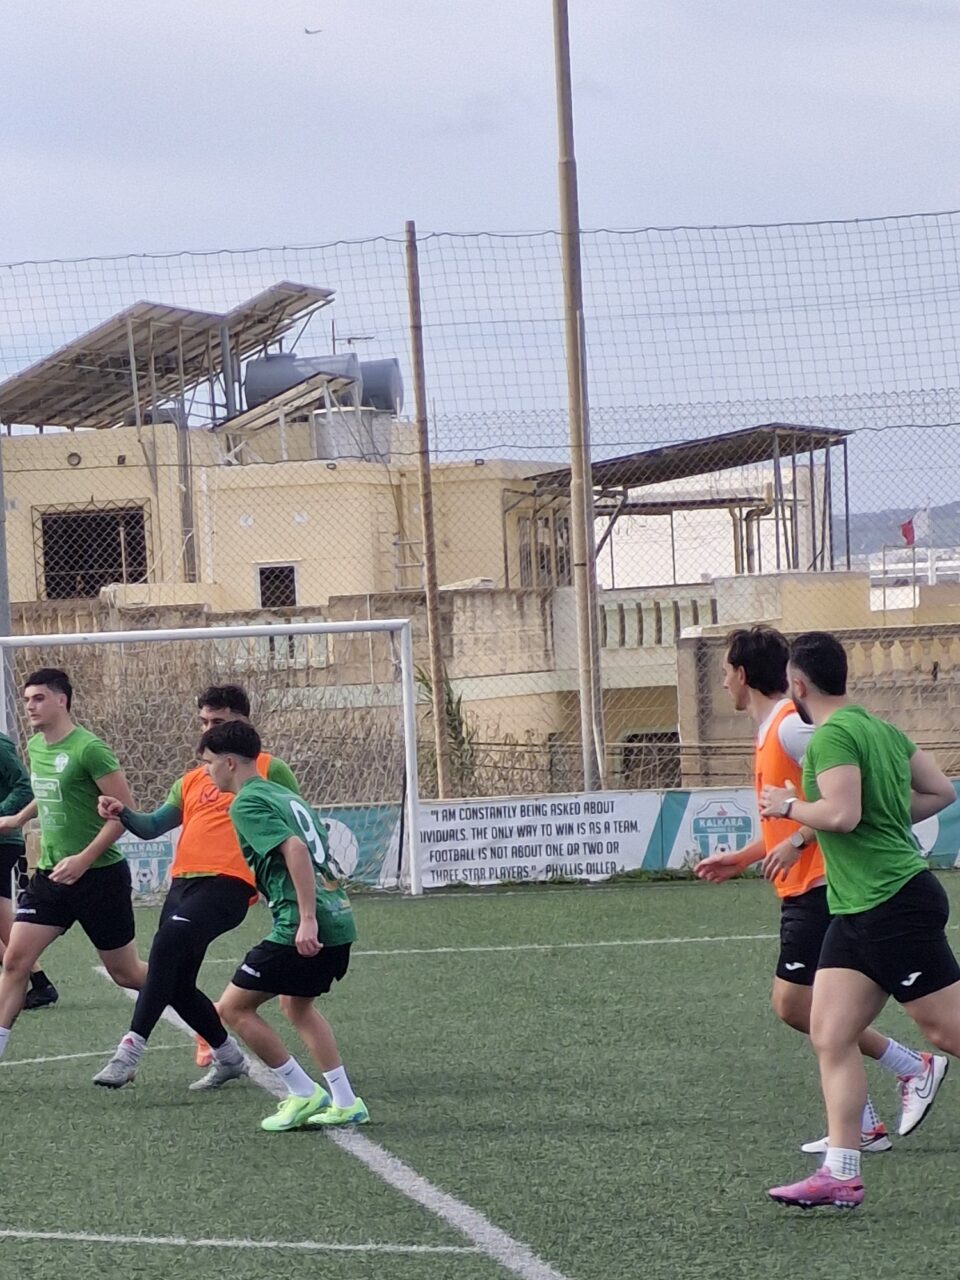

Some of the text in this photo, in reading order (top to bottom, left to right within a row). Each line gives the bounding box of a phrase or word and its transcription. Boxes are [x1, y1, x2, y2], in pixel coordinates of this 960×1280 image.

[441, 807, 456, 821] AM
[459, 805, 517, 821] CONSTANTLY
[520, 803, 548, 818] BEING
[550, 801, 581, 816] ASKED
[583, 800, 615, 815] ABOUT
[290, 800, 325, 864] 9
[471, 826, 488, 840] THE
[491, 825, 514, 840] ONLY
[516, 824, 538, 838] WAY
[541, 823, 552, 837] TO
[555, 822, 574, 836] WIN
[577, 821, 586, 835] IS
[589, 821, 601, 835] AS
[604, 820, 611, 834] A
[613, 820, 640, 834] TEAM.
[699, 817, 744, 828] KALKARA
[429, 840, 619, 863] FOOTBALL IS NOT ABOUT ONE OR TWO OR
[430, 868, 459, 882] THREE
[462, 867, 487, 881] STAR
[545, 862, 584, 877] PHYLLIS
